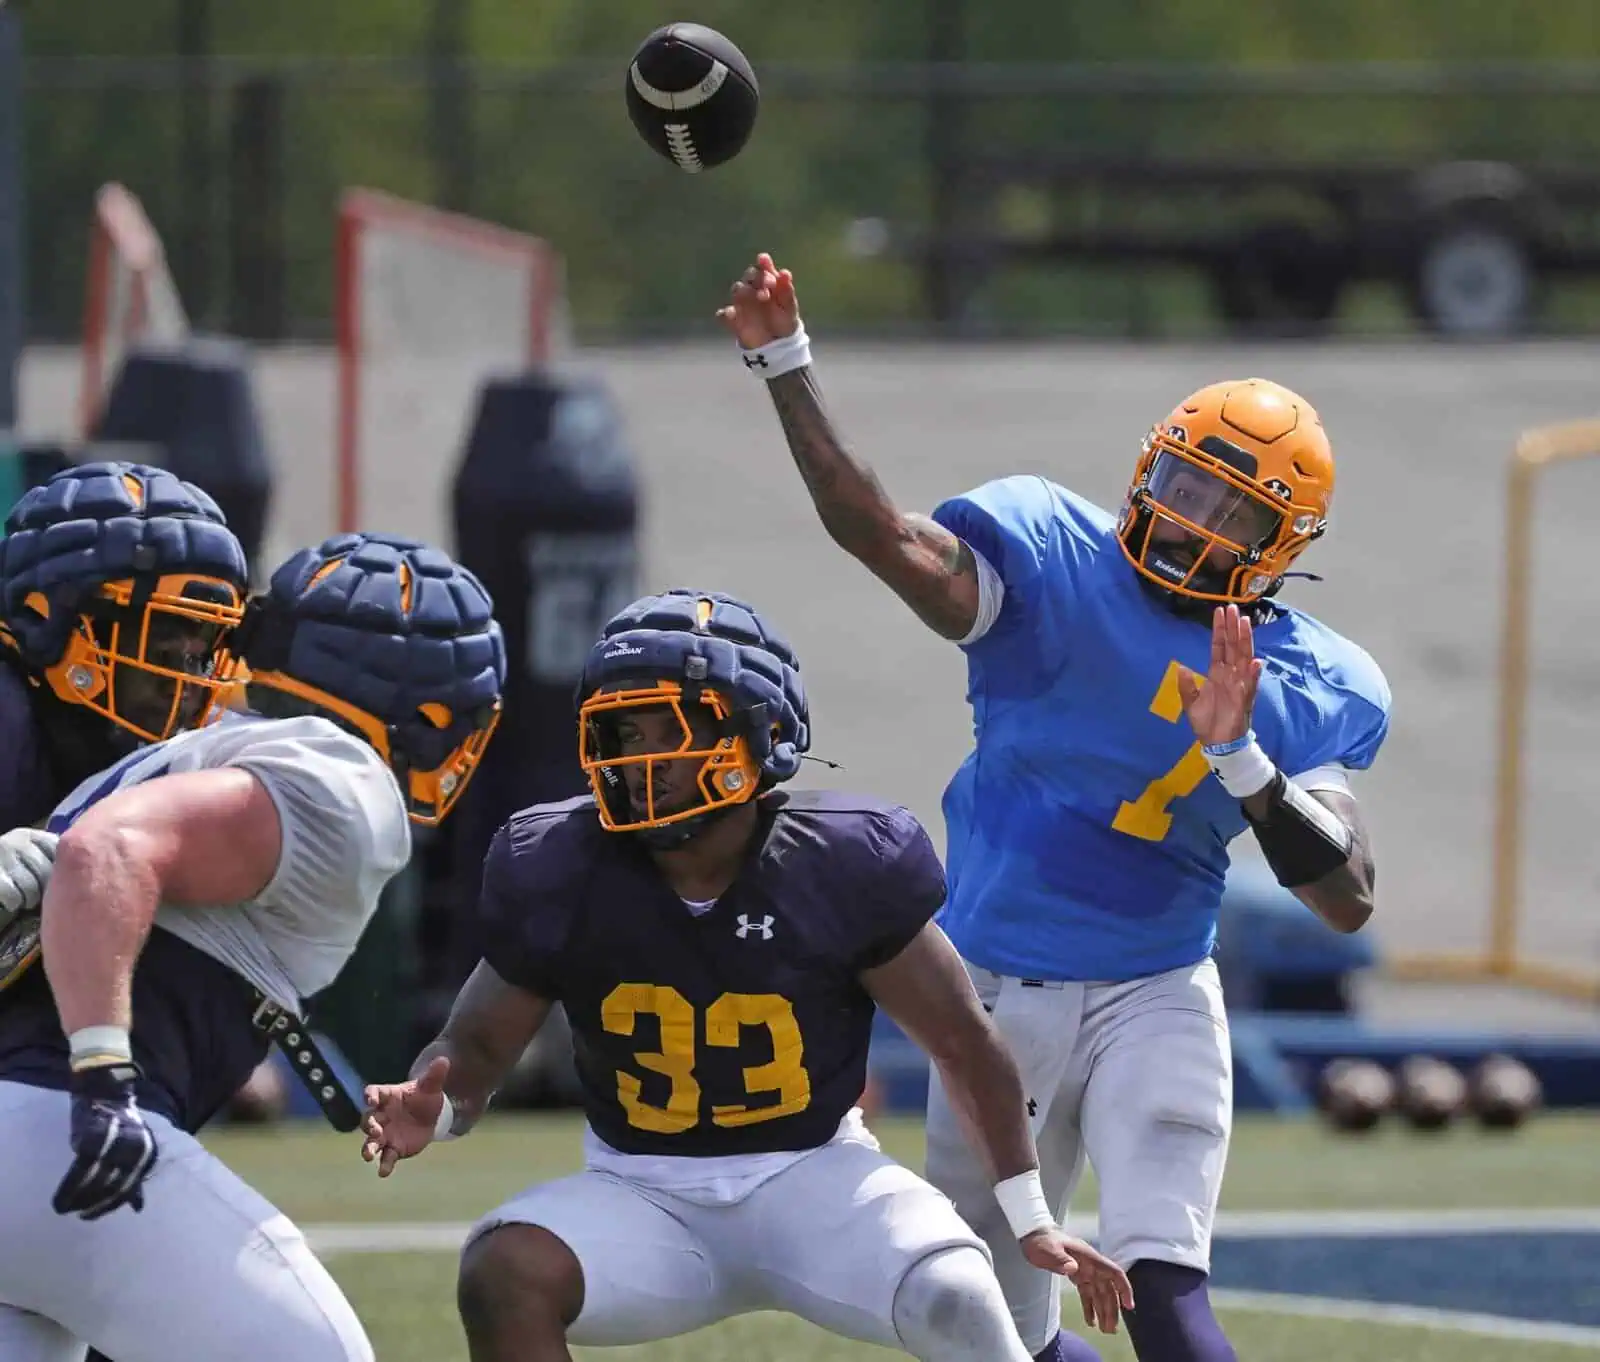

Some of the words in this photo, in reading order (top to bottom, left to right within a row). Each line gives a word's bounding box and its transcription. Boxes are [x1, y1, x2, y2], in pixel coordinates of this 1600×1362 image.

[604, 647, 643, 659] GUARDIAN
[1111, 660, 1212, 841] 7
[601, 982, 812, 1134] 33
